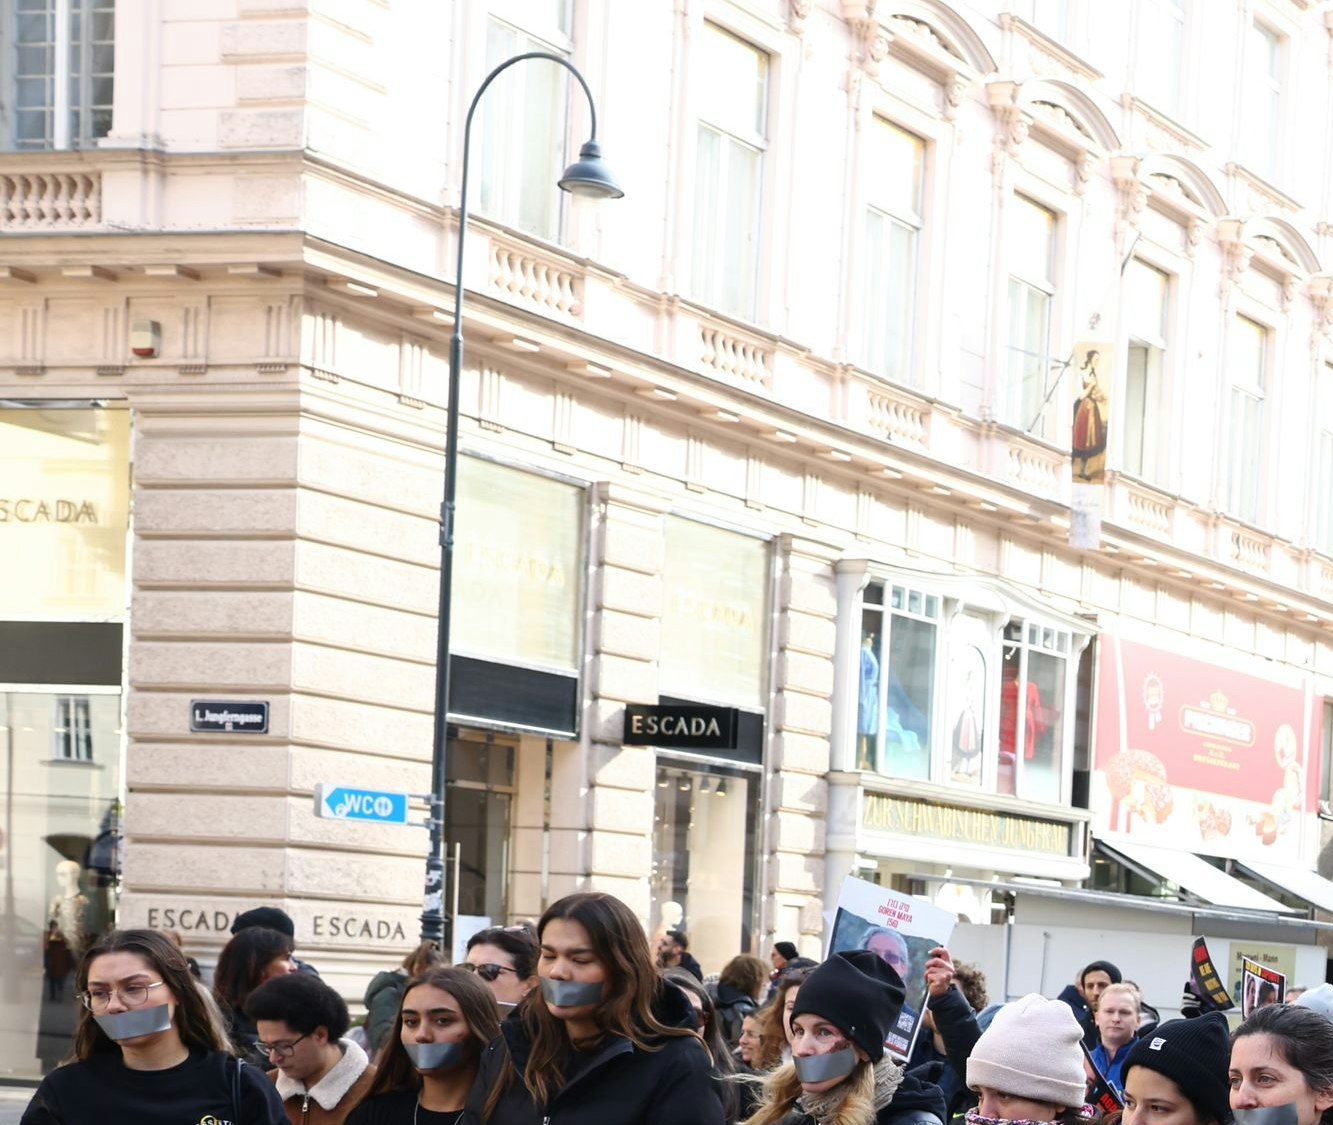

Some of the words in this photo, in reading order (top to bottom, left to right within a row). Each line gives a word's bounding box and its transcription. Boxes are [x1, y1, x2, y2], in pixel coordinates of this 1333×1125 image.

[631, 714, 721, 737] ESCADA
[343, 792, 375, 815] WC
[313, 915, 406, 941] ESCADA
